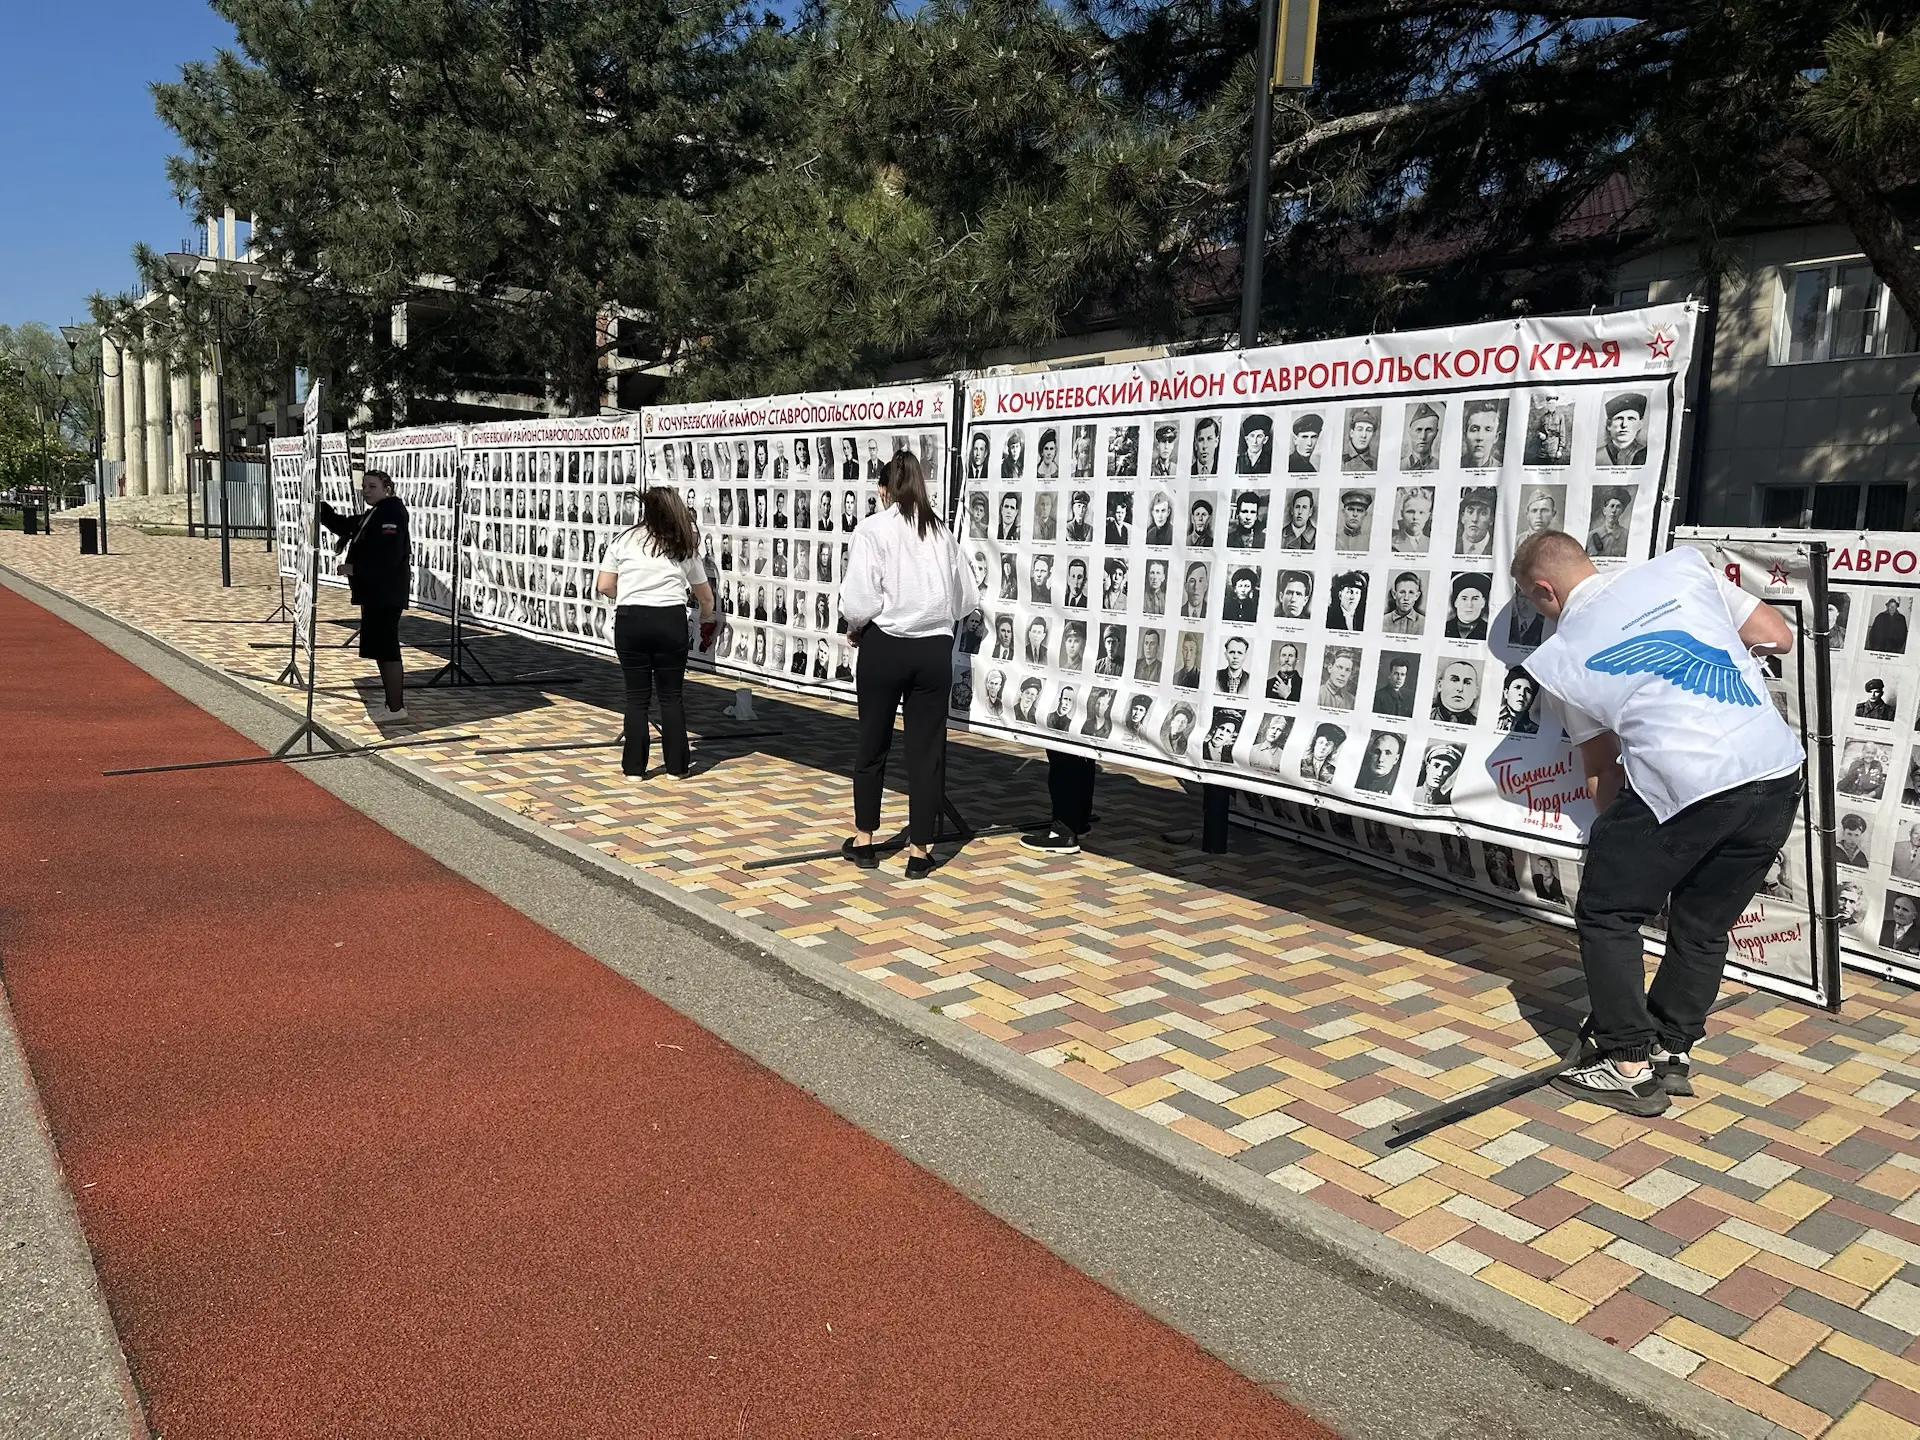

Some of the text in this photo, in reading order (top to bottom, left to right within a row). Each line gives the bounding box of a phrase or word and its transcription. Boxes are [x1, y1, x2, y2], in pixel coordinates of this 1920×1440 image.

[998, 340, 1621, 414] КОЧУБЕЕВСКИЙ РАЙОН СТАВРОПОЛЬСКОГО КРАЯ
[611, 425, 630, 440] КРАЯ
[657, 399, 924, 432] КОЧУБЕЕВСКИЙ РАЙОН СТАВРОПОЛЬСКОГО КРАЯ
[1491, 751, 1573, 795] Помним!
[1729, 922, 1802, 960] Гордимся!
